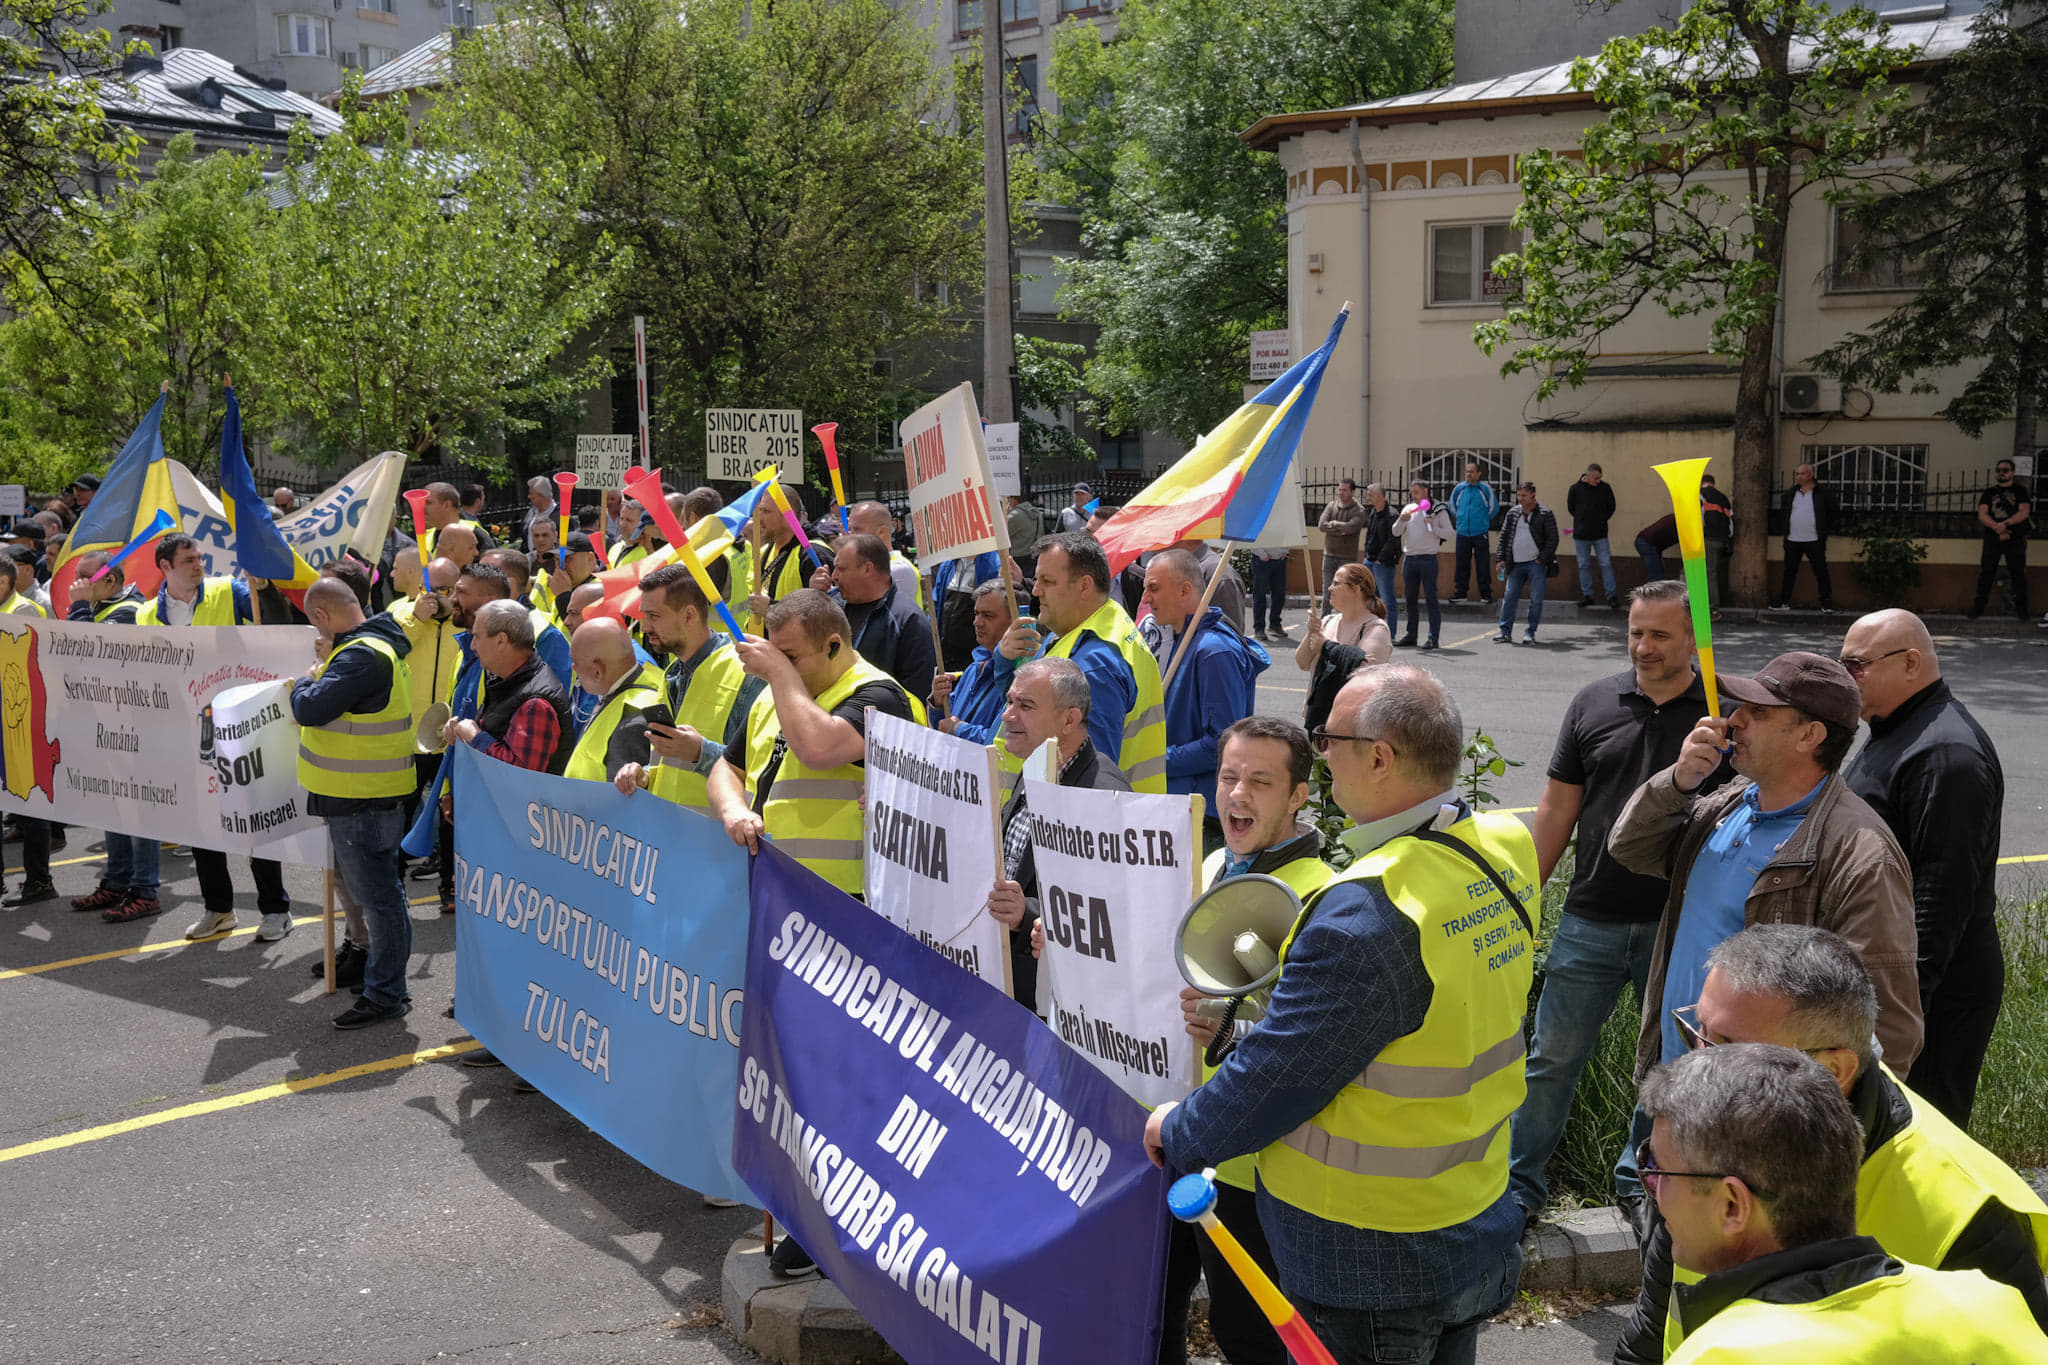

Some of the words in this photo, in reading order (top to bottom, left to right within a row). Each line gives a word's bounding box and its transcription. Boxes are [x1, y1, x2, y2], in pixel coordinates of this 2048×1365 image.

[708, 412, 799, 434] SINDICATUL
[577, 437, 629, 453] SINDICATUL
[577, 455, 600, 470] LIBER
[609, 455, 629, 470] 2015
[708, 435, 748, 455] LIBER
[766, 437, 799, 457] 2015
[584, 472, 620, 487] BRASOV
[924, 477, 995, 555] CONSUMĂ!
[48, 632, 95, 664] Federația
[96, 635, 184, 668] Transportatorilor
[184, 642, 195, 674] și
[64, 673, 112, 702] Serviciilor
[113, 680, 151, 712] publice
[152, 682, 169, 710] din
[96, 722, 139, 752] România
[214, 719, 250, 741] aritate
[251, 716, 260, 733] cu
[261, 703, 285, 726] S.T.B.
[66, 767, 80, 791] Noi
[82, 776, 109, 798] punem
[141, 780, 177, 809] mișcare!
[889, 746, 898, 776] de
[897, 748, 940, 793] Solidaritate
[940, 770, 953, 798] cu
[953, 768, 983, 806] S.T.B.
[233, 811, 247, 834] În
[249, 798, 298, 834] Mișcare!
[527, 801, 659, 904] SINDICATUL
[873, 800, 949, 883] SLATINA
[1098, 827, 1121, 864] cu
[1124, 828, 1178, 868] S.T.B.
[454, 852, 631, 993] TRANSPORTULUI
[1472, 936, 1484, 957] ȘI
[1484, 923, 1510, 948] SERV.
[1488, 940, 1525, 973] ROMÂNIA
[523, 980, 610, 1083] TULCEA
[1055, 1001, 1084, 1048] ara
[1079, 1004, 1096, 1056] În
[1095, 1018, 1169, 1079] Mișcare!
[768, 910, 952, 1073] SINDICATUL
[933, 1031, 1112, 1207] ANGAJAȚILOR
[876, 1094, 949, 1180] DIN
[738, 1055, 770, 1124] SC
[769, 1082, 898, 1251] TRANSURB
[875, 1212, 929, 1294] SA
